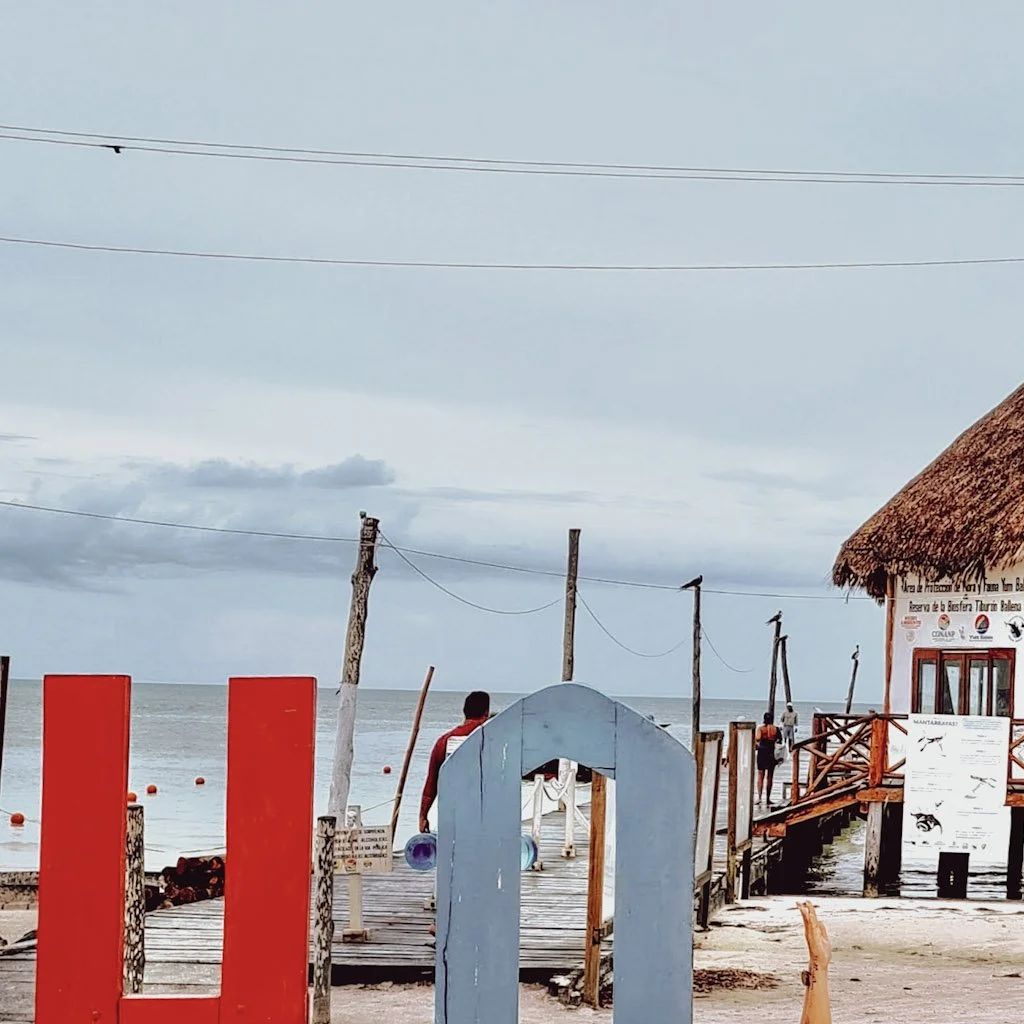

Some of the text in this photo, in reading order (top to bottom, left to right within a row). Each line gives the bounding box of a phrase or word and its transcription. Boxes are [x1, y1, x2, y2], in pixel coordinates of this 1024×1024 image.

[909, 601, 930, 613] Reserva
[932, 601, 939, 613] de
[947, 600, 973, 613] Biosfera
